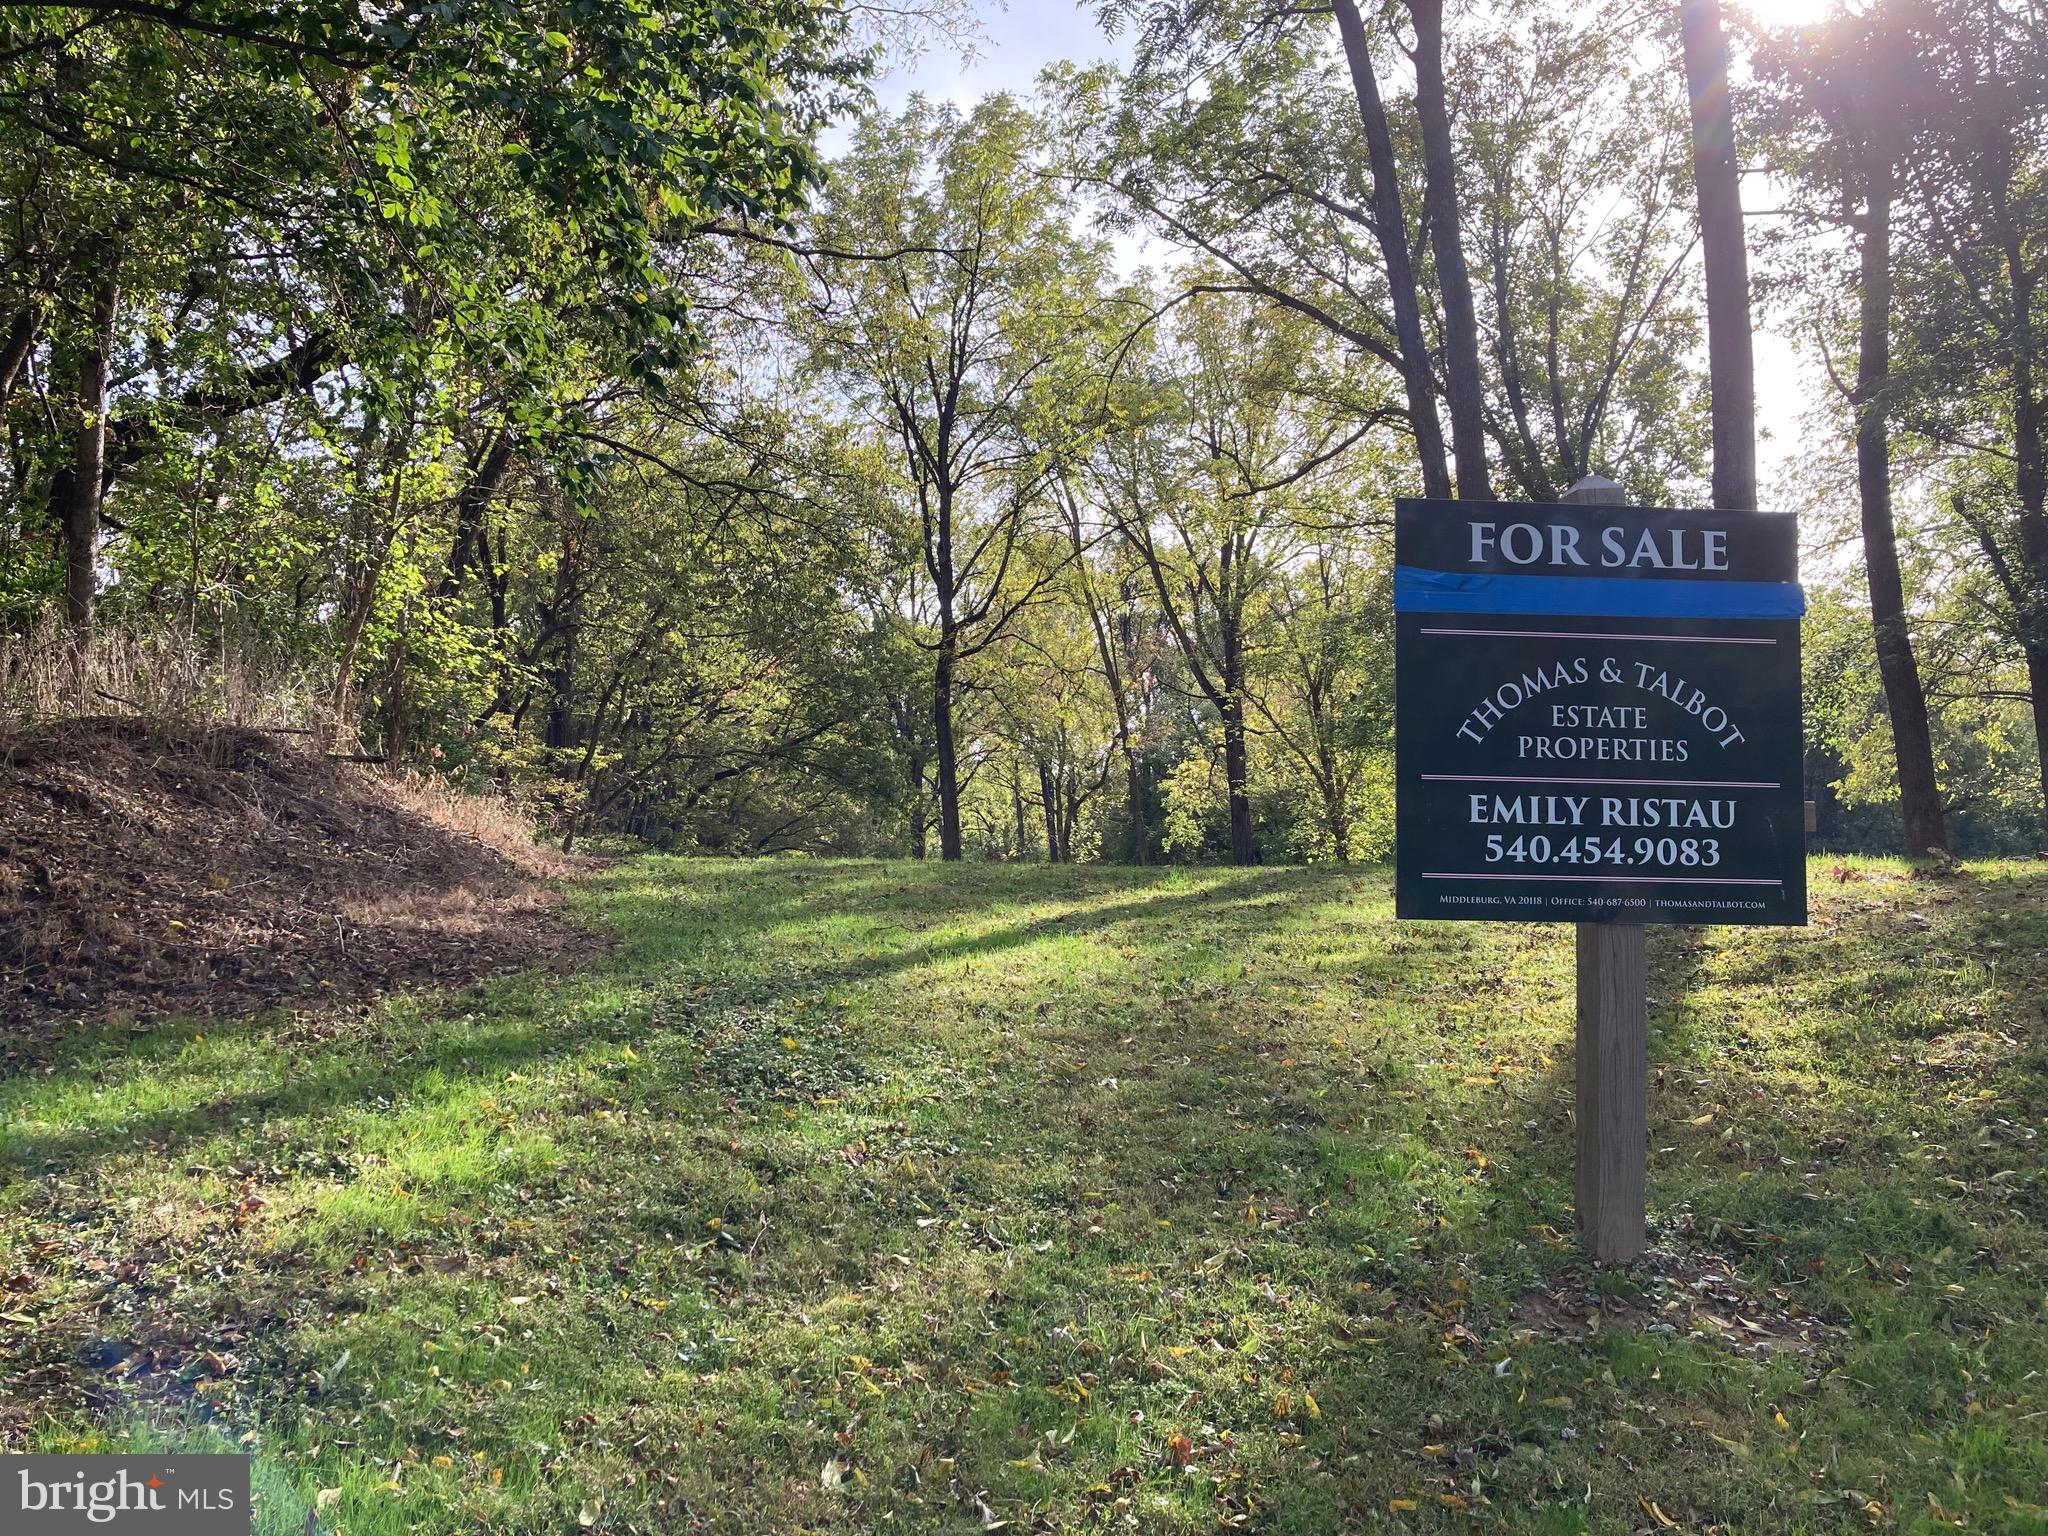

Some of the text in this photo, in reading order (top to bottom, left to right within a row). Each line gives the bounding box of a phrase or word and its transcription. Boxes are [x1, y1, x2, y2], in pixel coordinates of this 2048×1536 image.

[1467, 521, 1729, 571] FOR SALE
[1455, 657, 1746, 750] THOMAS & TALBOT
[1551, 705, 1648, 729] ESTATE
[1518, 735, 1689, 762] PROPERTIES
[1468, 794, 1737, 829] EMILY RISTAU
[1485, 834, 1721, 867] 540.454.9083
[1503, 896, 1517, 905] VA
[1518, 896, 1543, 905] 20118
[1587, 897, 1646, 907] 540-687-6500
